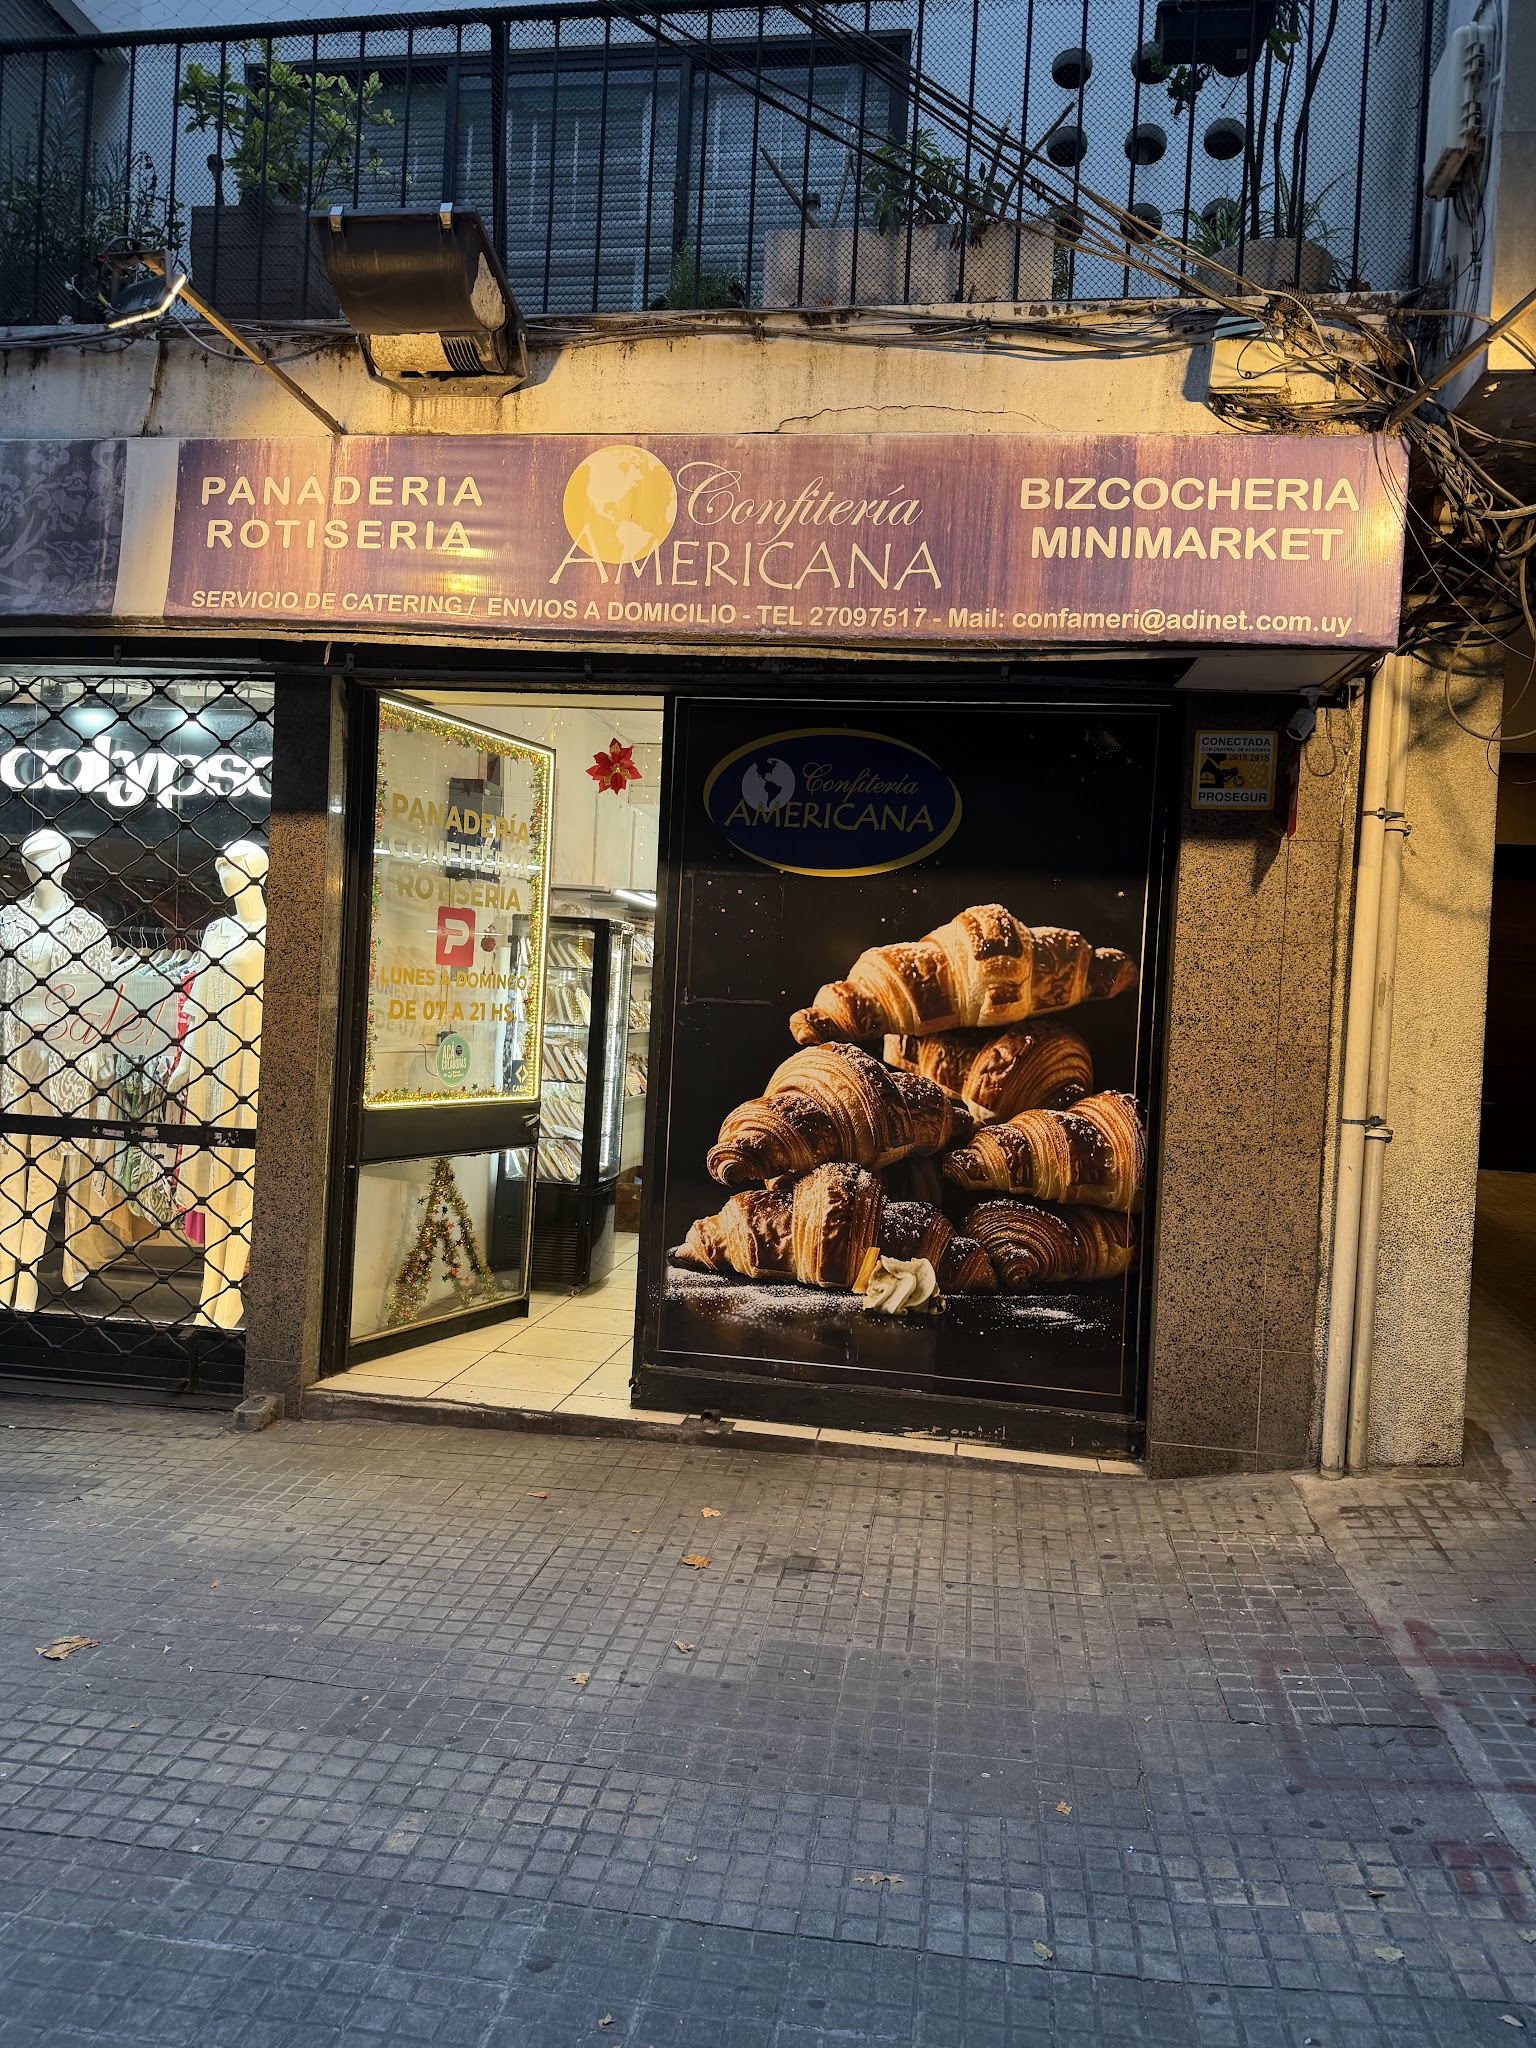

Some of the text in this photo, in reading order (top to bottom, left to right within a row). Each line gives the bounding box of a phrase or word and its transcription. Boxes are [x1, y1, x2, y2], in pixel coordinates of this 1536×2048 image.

[201, 476, 483, 507] PANADERIA
[676, 461, 924, 546] Confitería
[1019, 477, 1360, 512] BIZCOCHERIA
[206, 520, 472, 550] ROTISERIA
[1031, 526, 1344, 561] MINIMARKET
[548, 523, 942, 591] AMERICANA
[191, 590, 298, 609] SERVICIO
[304, 592, 335, 610] DE
[487, 597, 577, 619] ENVIOS
[583, 601, 600, 620] A
[607, 601, 737, 625] DOMICILIO
[757, 605, 803, 626] TEL
[810, 606, 925, 628] 27097517
[948, 607, 1004, 628] Mail:
[1012, 607, 1353, 638] confameri@adinet.com.uy
[1202, 737, 1271, 746] CONECTADA
[802, 762, 919, 802] Confitería
[1198, 792, 1267, 802] PROSEGUR
[392, 792, 531, 846] PANADERÍA
[724, 799, 934, 832] AMERICANA
[397, 872, 521, 912] ROTISERÍA
[379, 966, 528, 991] LUNES A DOMINGO
[389, 999, 417, 1020] DE
[423, 1000, 447, 1021] 07
[451, 1002, 465, 1021] A
[469, 1002, 486, 1021] 21
